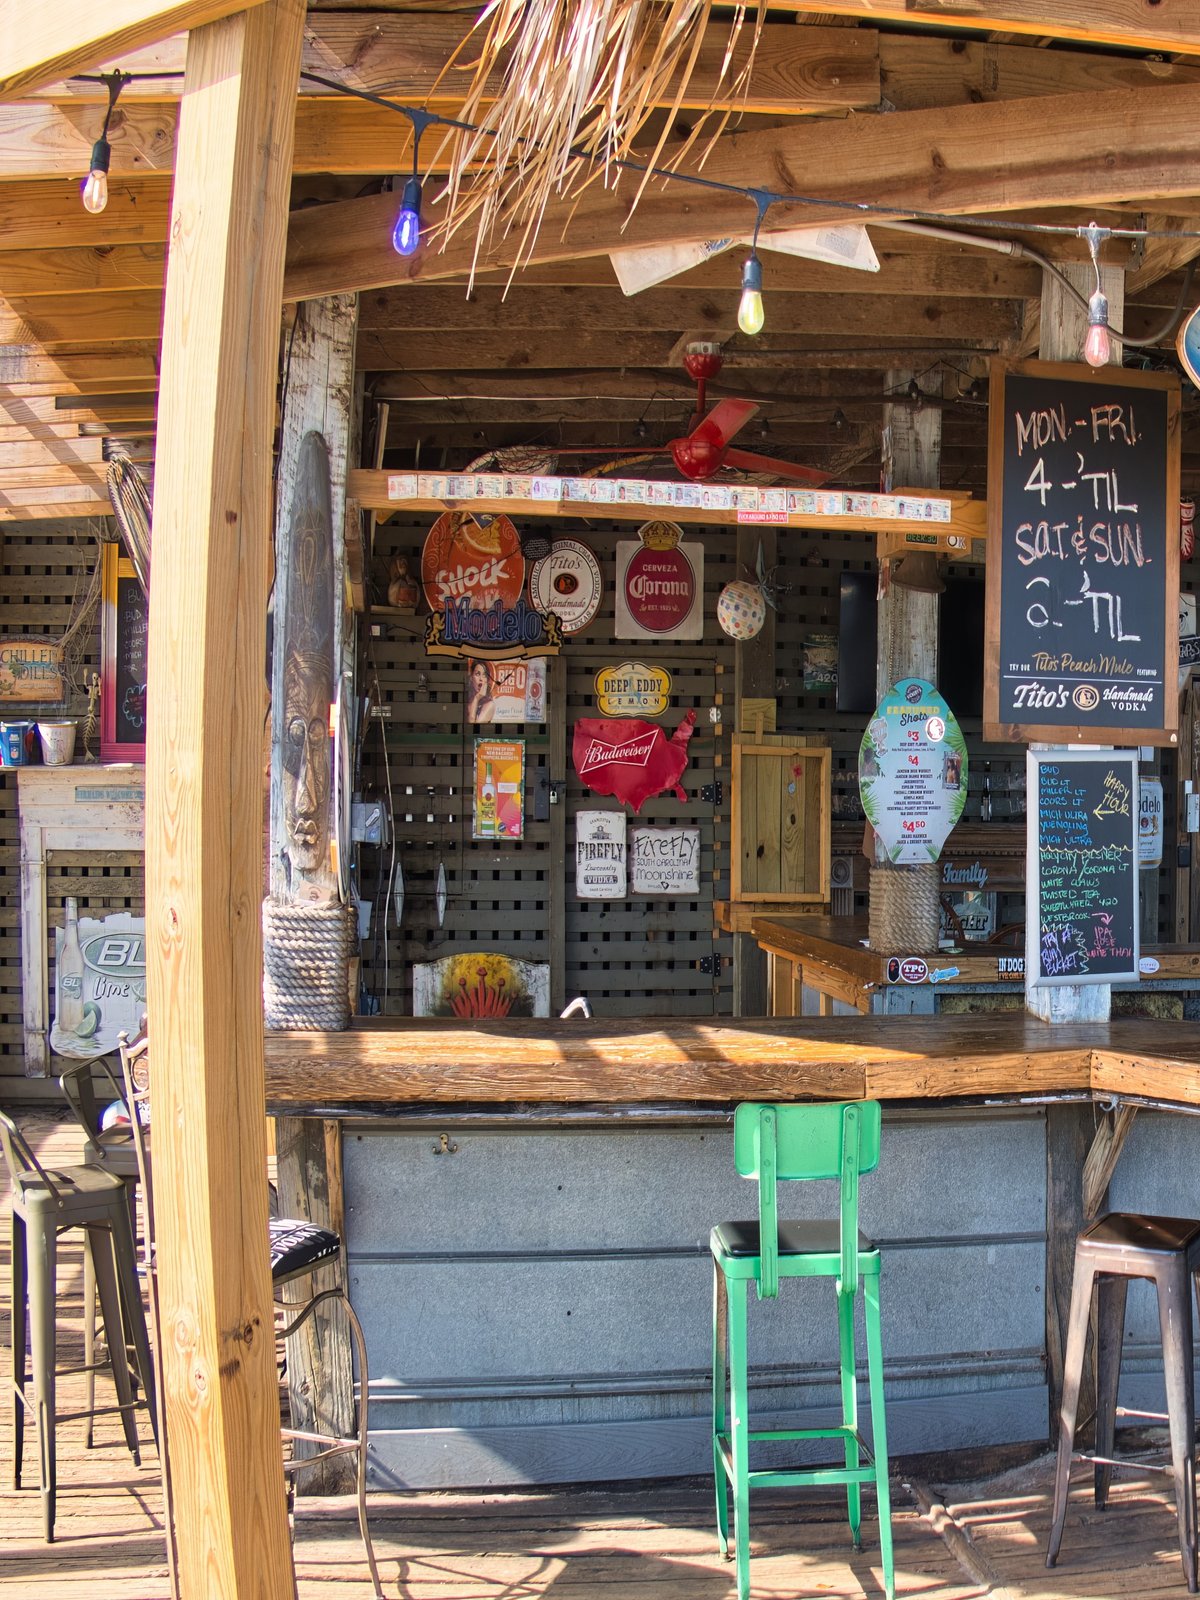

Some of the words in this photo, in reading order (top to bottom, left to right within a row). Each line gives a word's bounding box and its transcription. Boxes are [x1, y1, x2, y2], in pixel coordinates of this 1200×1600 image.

[1024, 458, 1052, 507] 4
[551, 556, 582, 570] Tito's
[642, 564, 678, 572] CERVEZA
[434, 557, 510, 597] SHOCK
[629, 574, 690, 600] Corona
[547, 597, 586, 608] Handmade
[444, 596, 543, 642] Modelo
[570, 611, 592, 630] TEXAS
[1032, 652, 1058, 672] Tito's
[1061, 653, 1098, 674] Peach
[1099, 653, 1134, 677] Mule
[604, 679, 629, 693] DEEP
[637, 679, 663, 693] EDDY
[607, 697, 661, 705] LEMON
[1012, 682, 1070, 709] Tito's
[1102, 685, 1154, 702] Handmade
[1111, 701, 1147, 711] VODKA
[900, 711, 929, 726] Shots
[907, 730, 919, 742] $3
[585, 743, 652, 764] Budweiser
[907, 755, 919, 766] $4
[1040, 764, 1060, 775] BUD
[1040, 777, 1058, 786] BUD
[1041, 786, 1072, 794] MILLER
[1040, 797, 1067, 805] COORS
[1139, 796, 1160, 813] delo
[577, 841, 624, 866] FIREFLY
[587, 875, 614, 884] VODKA
[636, 868, 694, 880] Moonshine
[943, 861, 988, 888] Family
[903, 964, 925, 973] TPC
[1008, 958, 1024, 972] DOG
